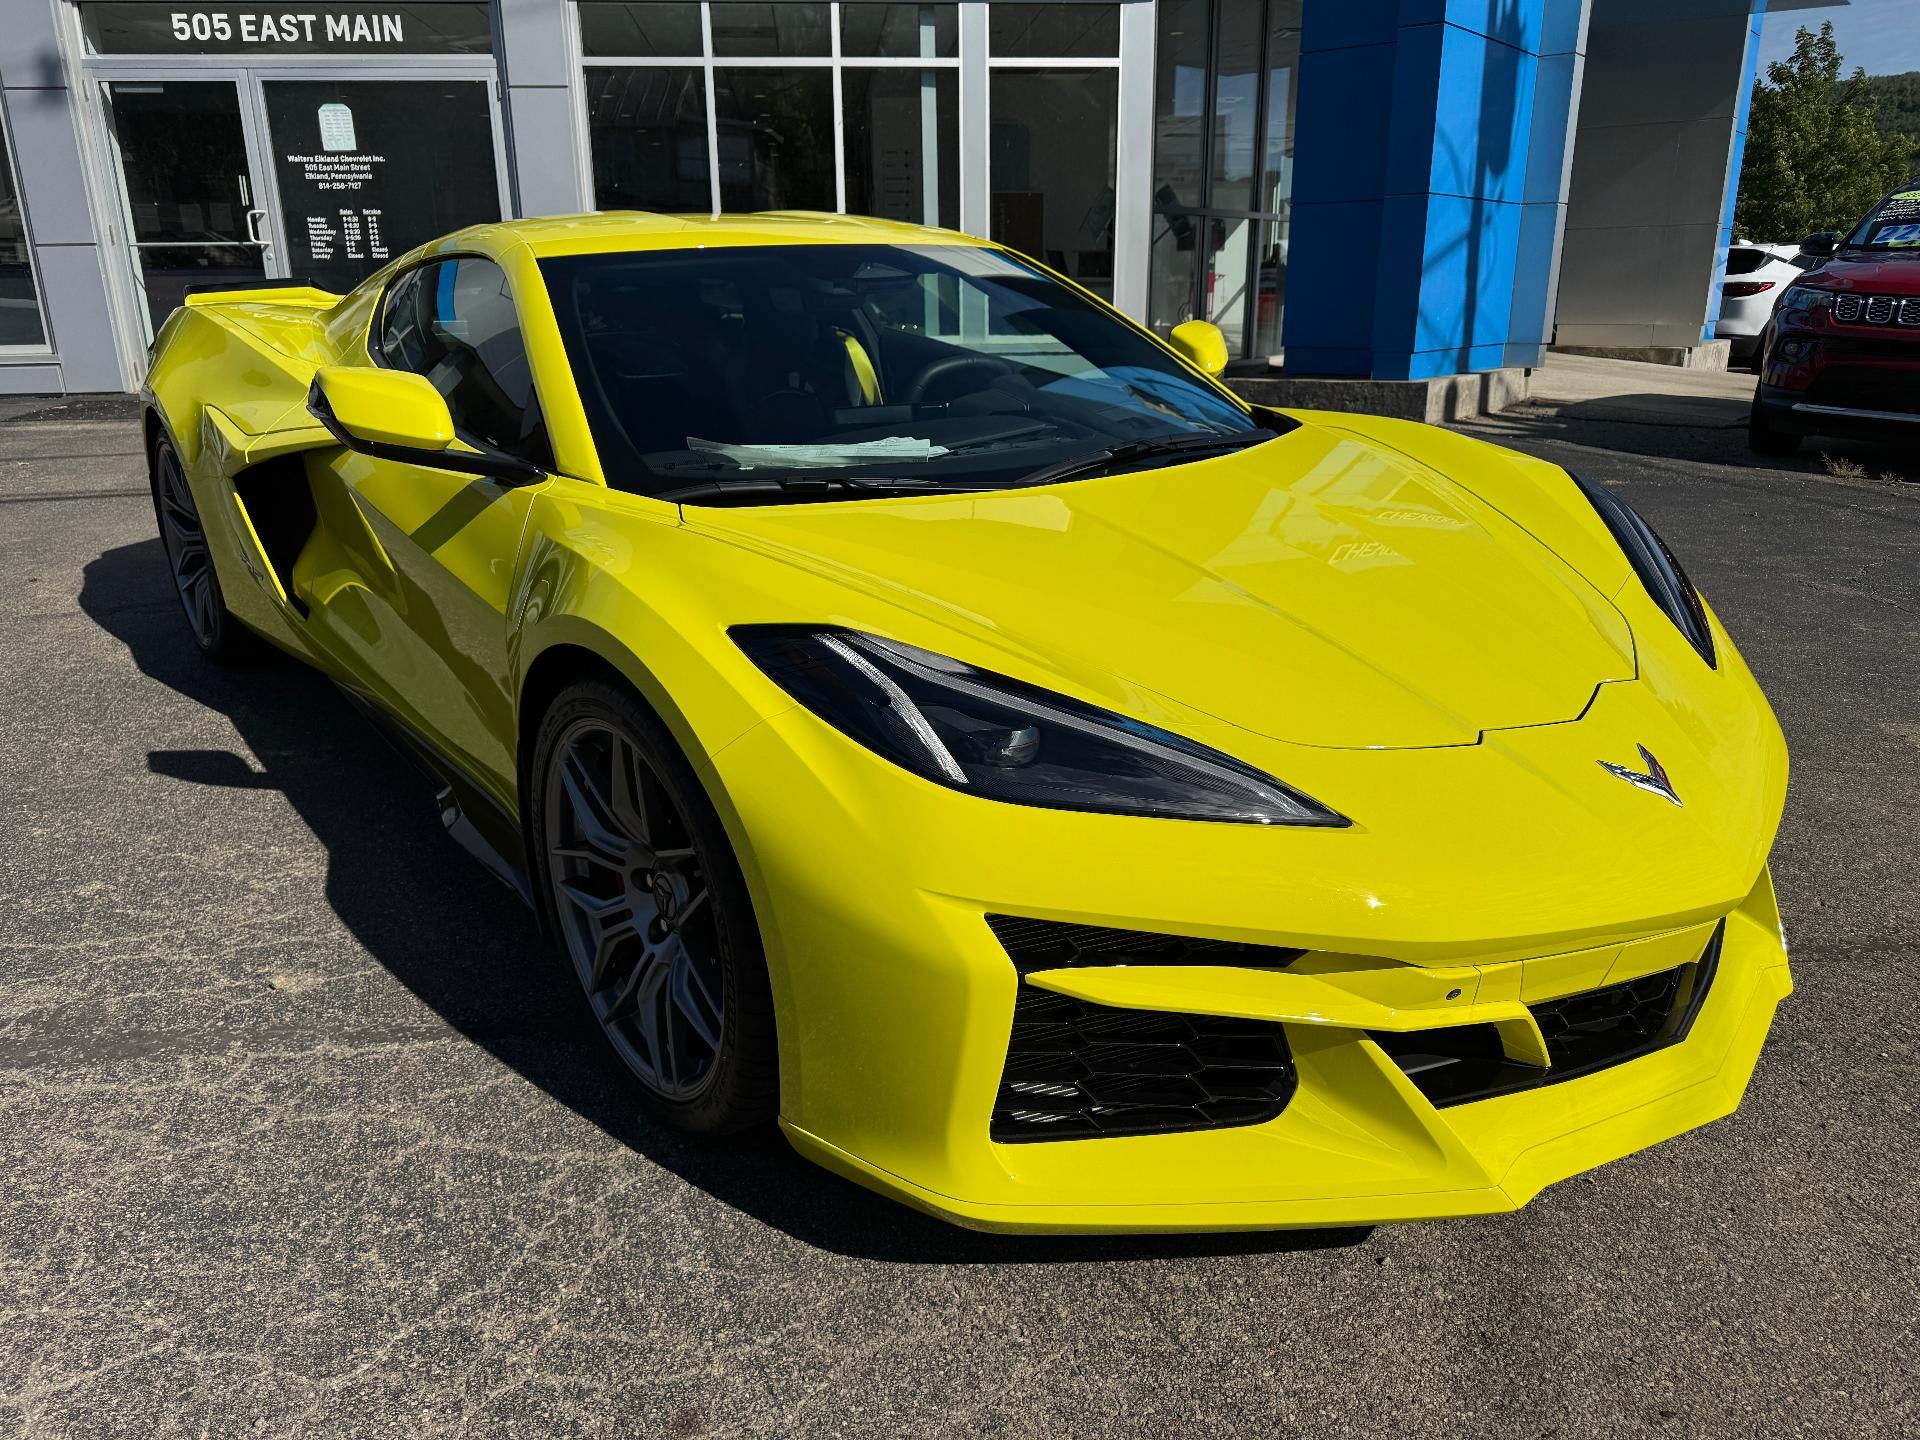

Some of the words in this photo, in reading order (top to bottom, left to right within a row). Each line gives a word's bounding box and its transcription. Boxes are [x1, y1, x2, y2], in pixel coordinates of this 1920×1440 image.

[171, 13, 232, 41] 505
[239, 14, 317, 42] EAST
[325, 14, 404, 42] MAIN
[287, 155, 314, 163] Walters
[314, 155, 339, 163] Elkland
[340, 155, 372, 163] Chevrolet
[372, 155, 386, 163] Inc.
[304, 163, 318, 171] 505
[318, 163, 333, 171] East
[333, 163, 350, 171] Main
[350, 163, 371, 171] Street
[305, 172, 331, 181] Elkland,
[330, 172, 373, 181] Pennsylvania
[309, 234, 333, 242] Thursday
[311, 246, 334, 254] Saturday
[312, 252, 331, 260] Sunday
